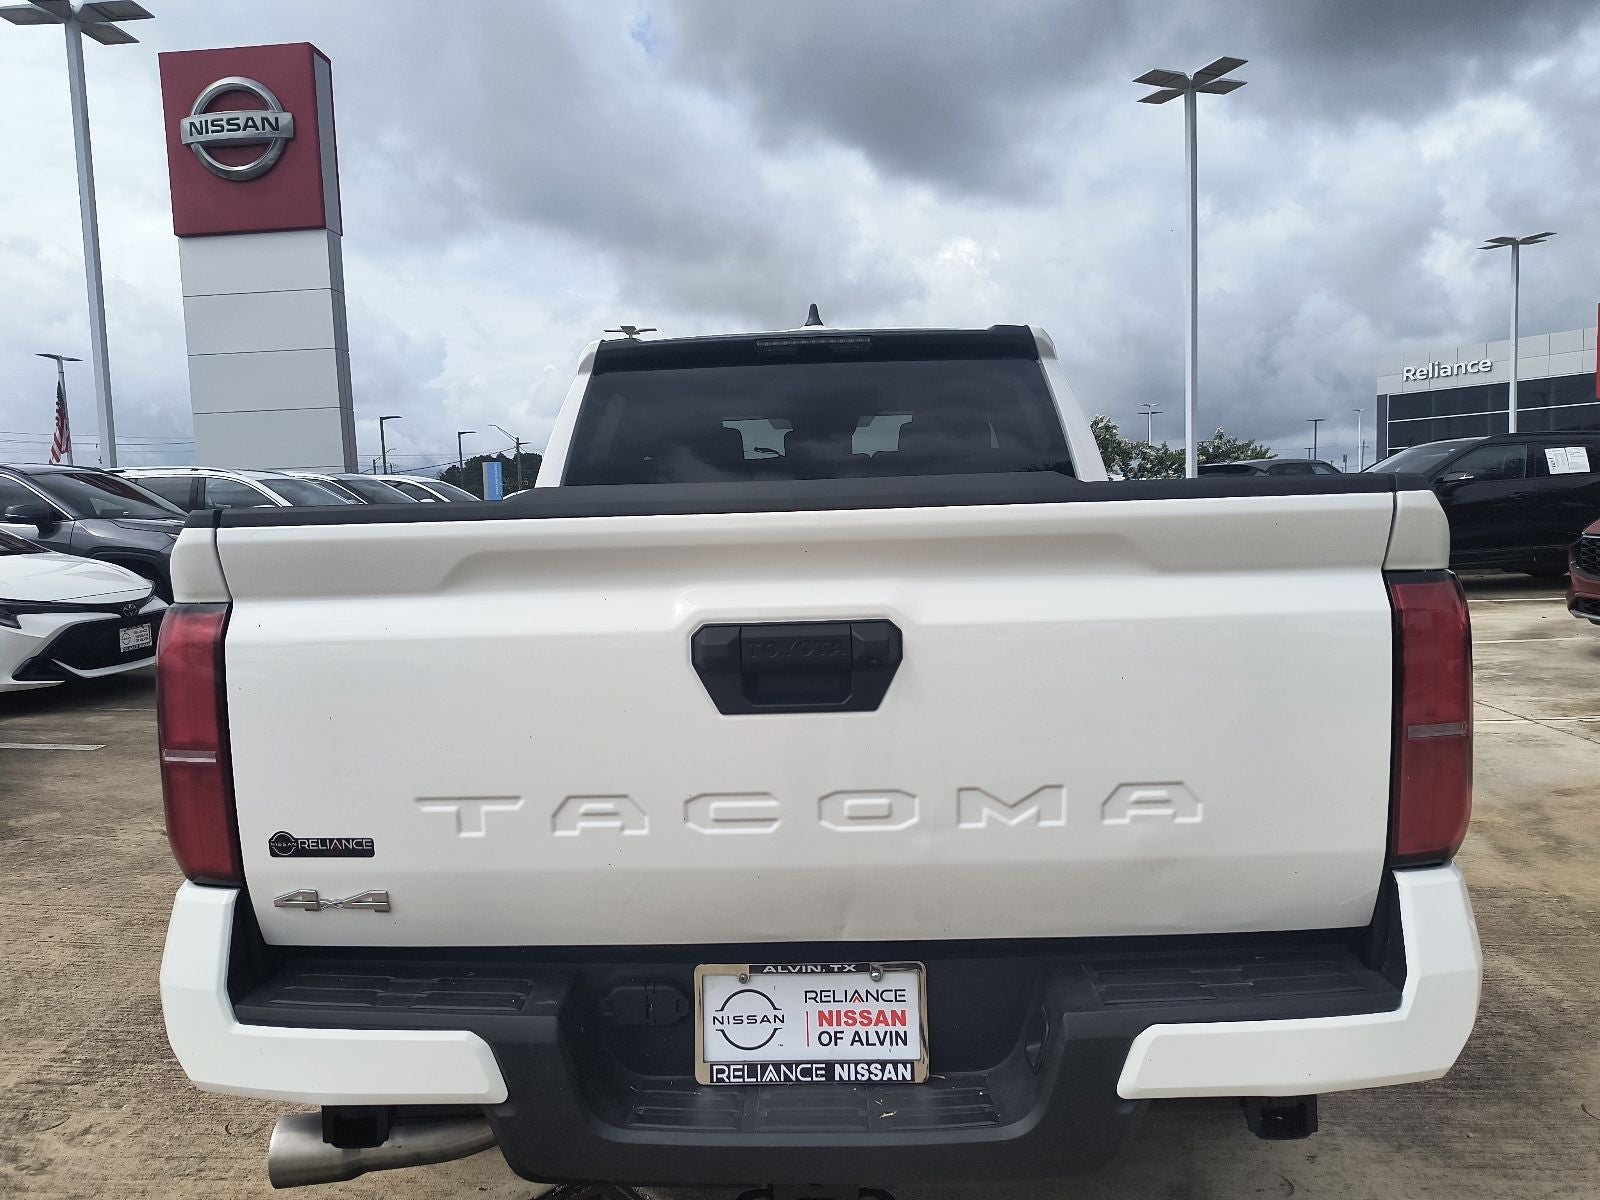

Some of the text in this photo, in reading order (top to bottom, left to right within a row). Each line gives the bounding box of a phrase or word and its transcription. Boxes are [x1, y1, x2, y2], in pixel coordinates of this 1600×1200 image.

[189, 116, 280, 137] NISSAN
[1403, 359, 1492, 381] Reliance
[747, 639, 848, 659] TOYOTA
[415, 781, 1204, 838] TACOMA
[298, 838, 373, 850] RELIANCE
[829, 964, 857, 972] TX
[804, 988, 907, 1004] RELIANCE
[712, 1013, 785, 1026] NISSAN
[817, 1009, 907, 1027] NISSAN
[817, 1030, 908, 1047] OF ALVIN
[712, 1062, 912, 1083] RELIANCE NISSAN
